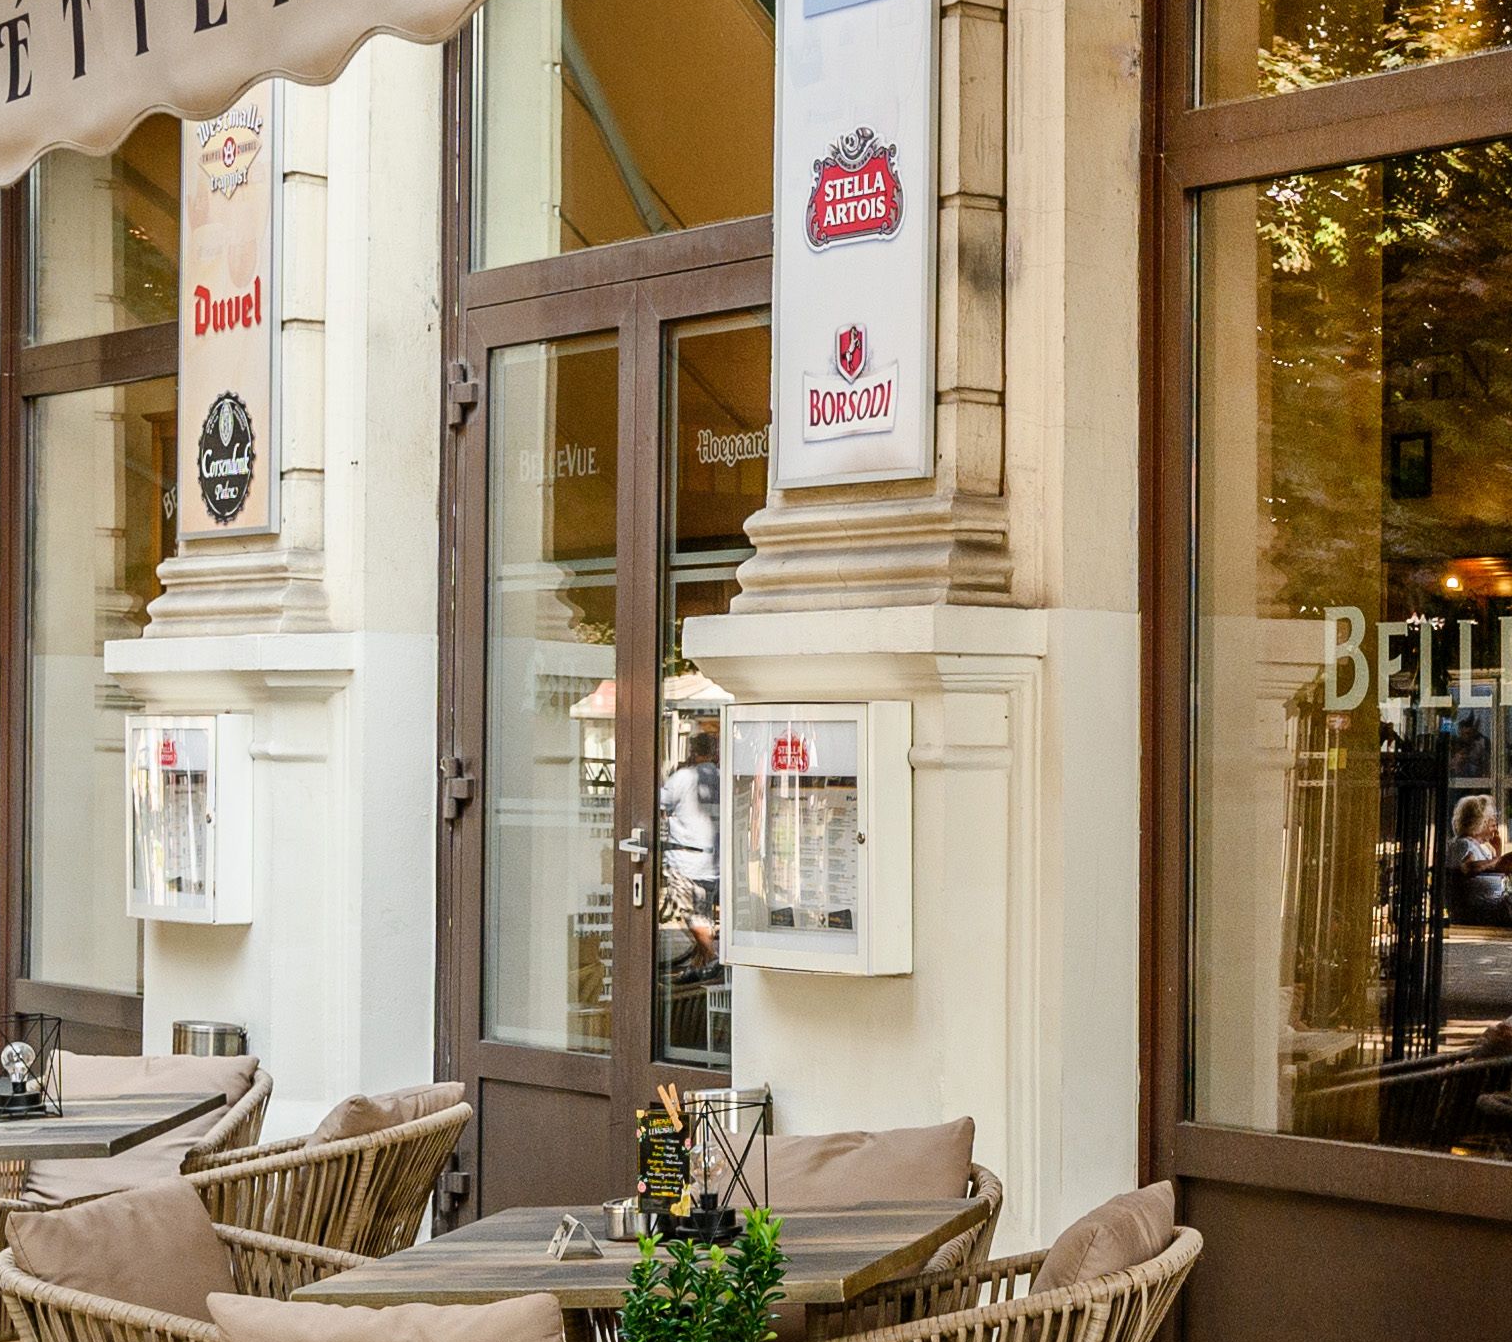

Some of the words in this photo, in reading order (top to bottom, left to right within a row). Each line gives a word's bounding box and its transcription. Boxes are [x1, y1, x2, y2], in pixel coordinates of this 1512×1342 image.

[197, 103, 263, 147] Westmalle
[824, 171, 885, 202] STELLA
[822, 196, 886, 227] ARTOIS
[194, 277, 262, 335] Duvel
[809, 380, 892, 427] BORSODI
